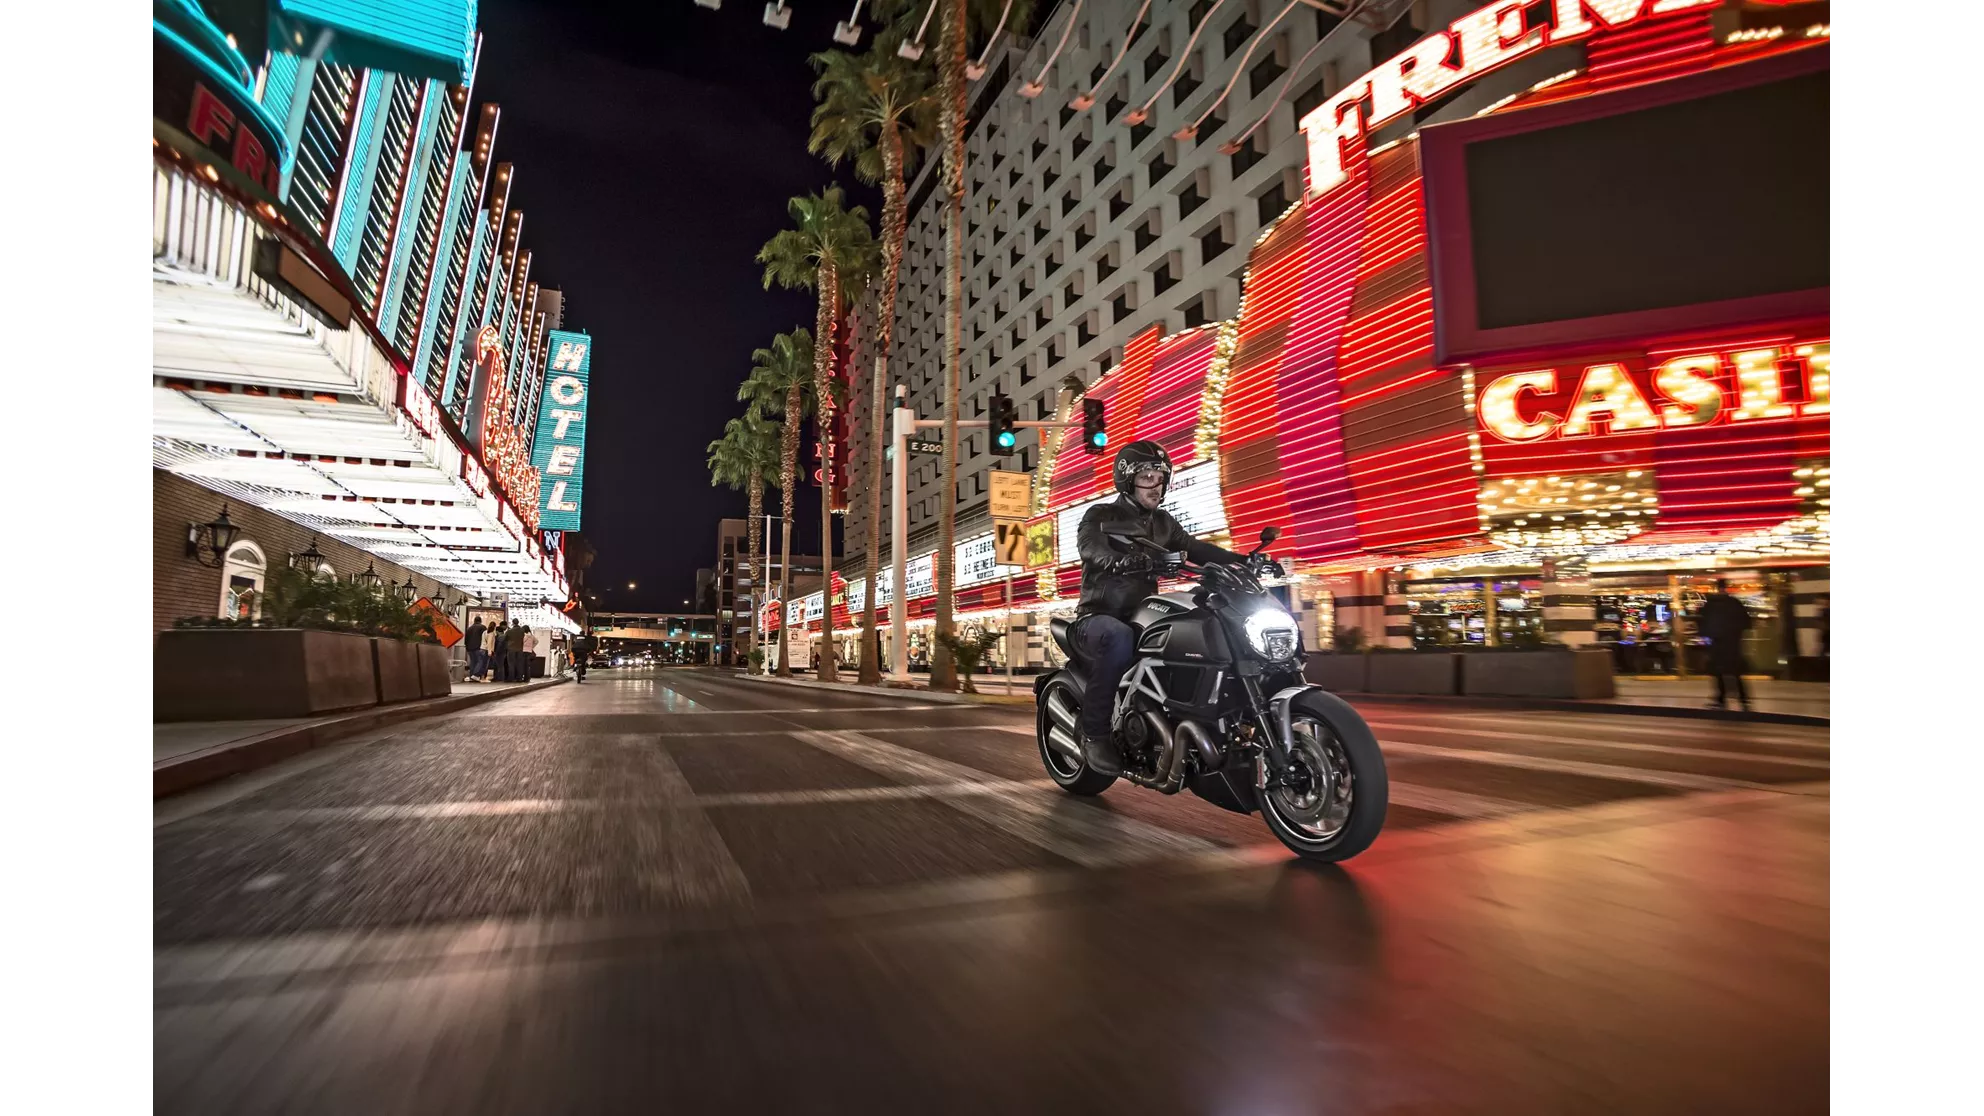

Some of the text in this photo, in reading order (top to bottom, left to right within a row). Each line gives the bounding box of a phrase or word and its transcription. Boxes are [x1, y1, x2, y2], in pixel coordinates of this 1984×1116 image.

[546, 341, 588, 513] HOTEL
[911, 441, 943, 453] E 200
[1147, 601, 1171, 614] DUCATI
